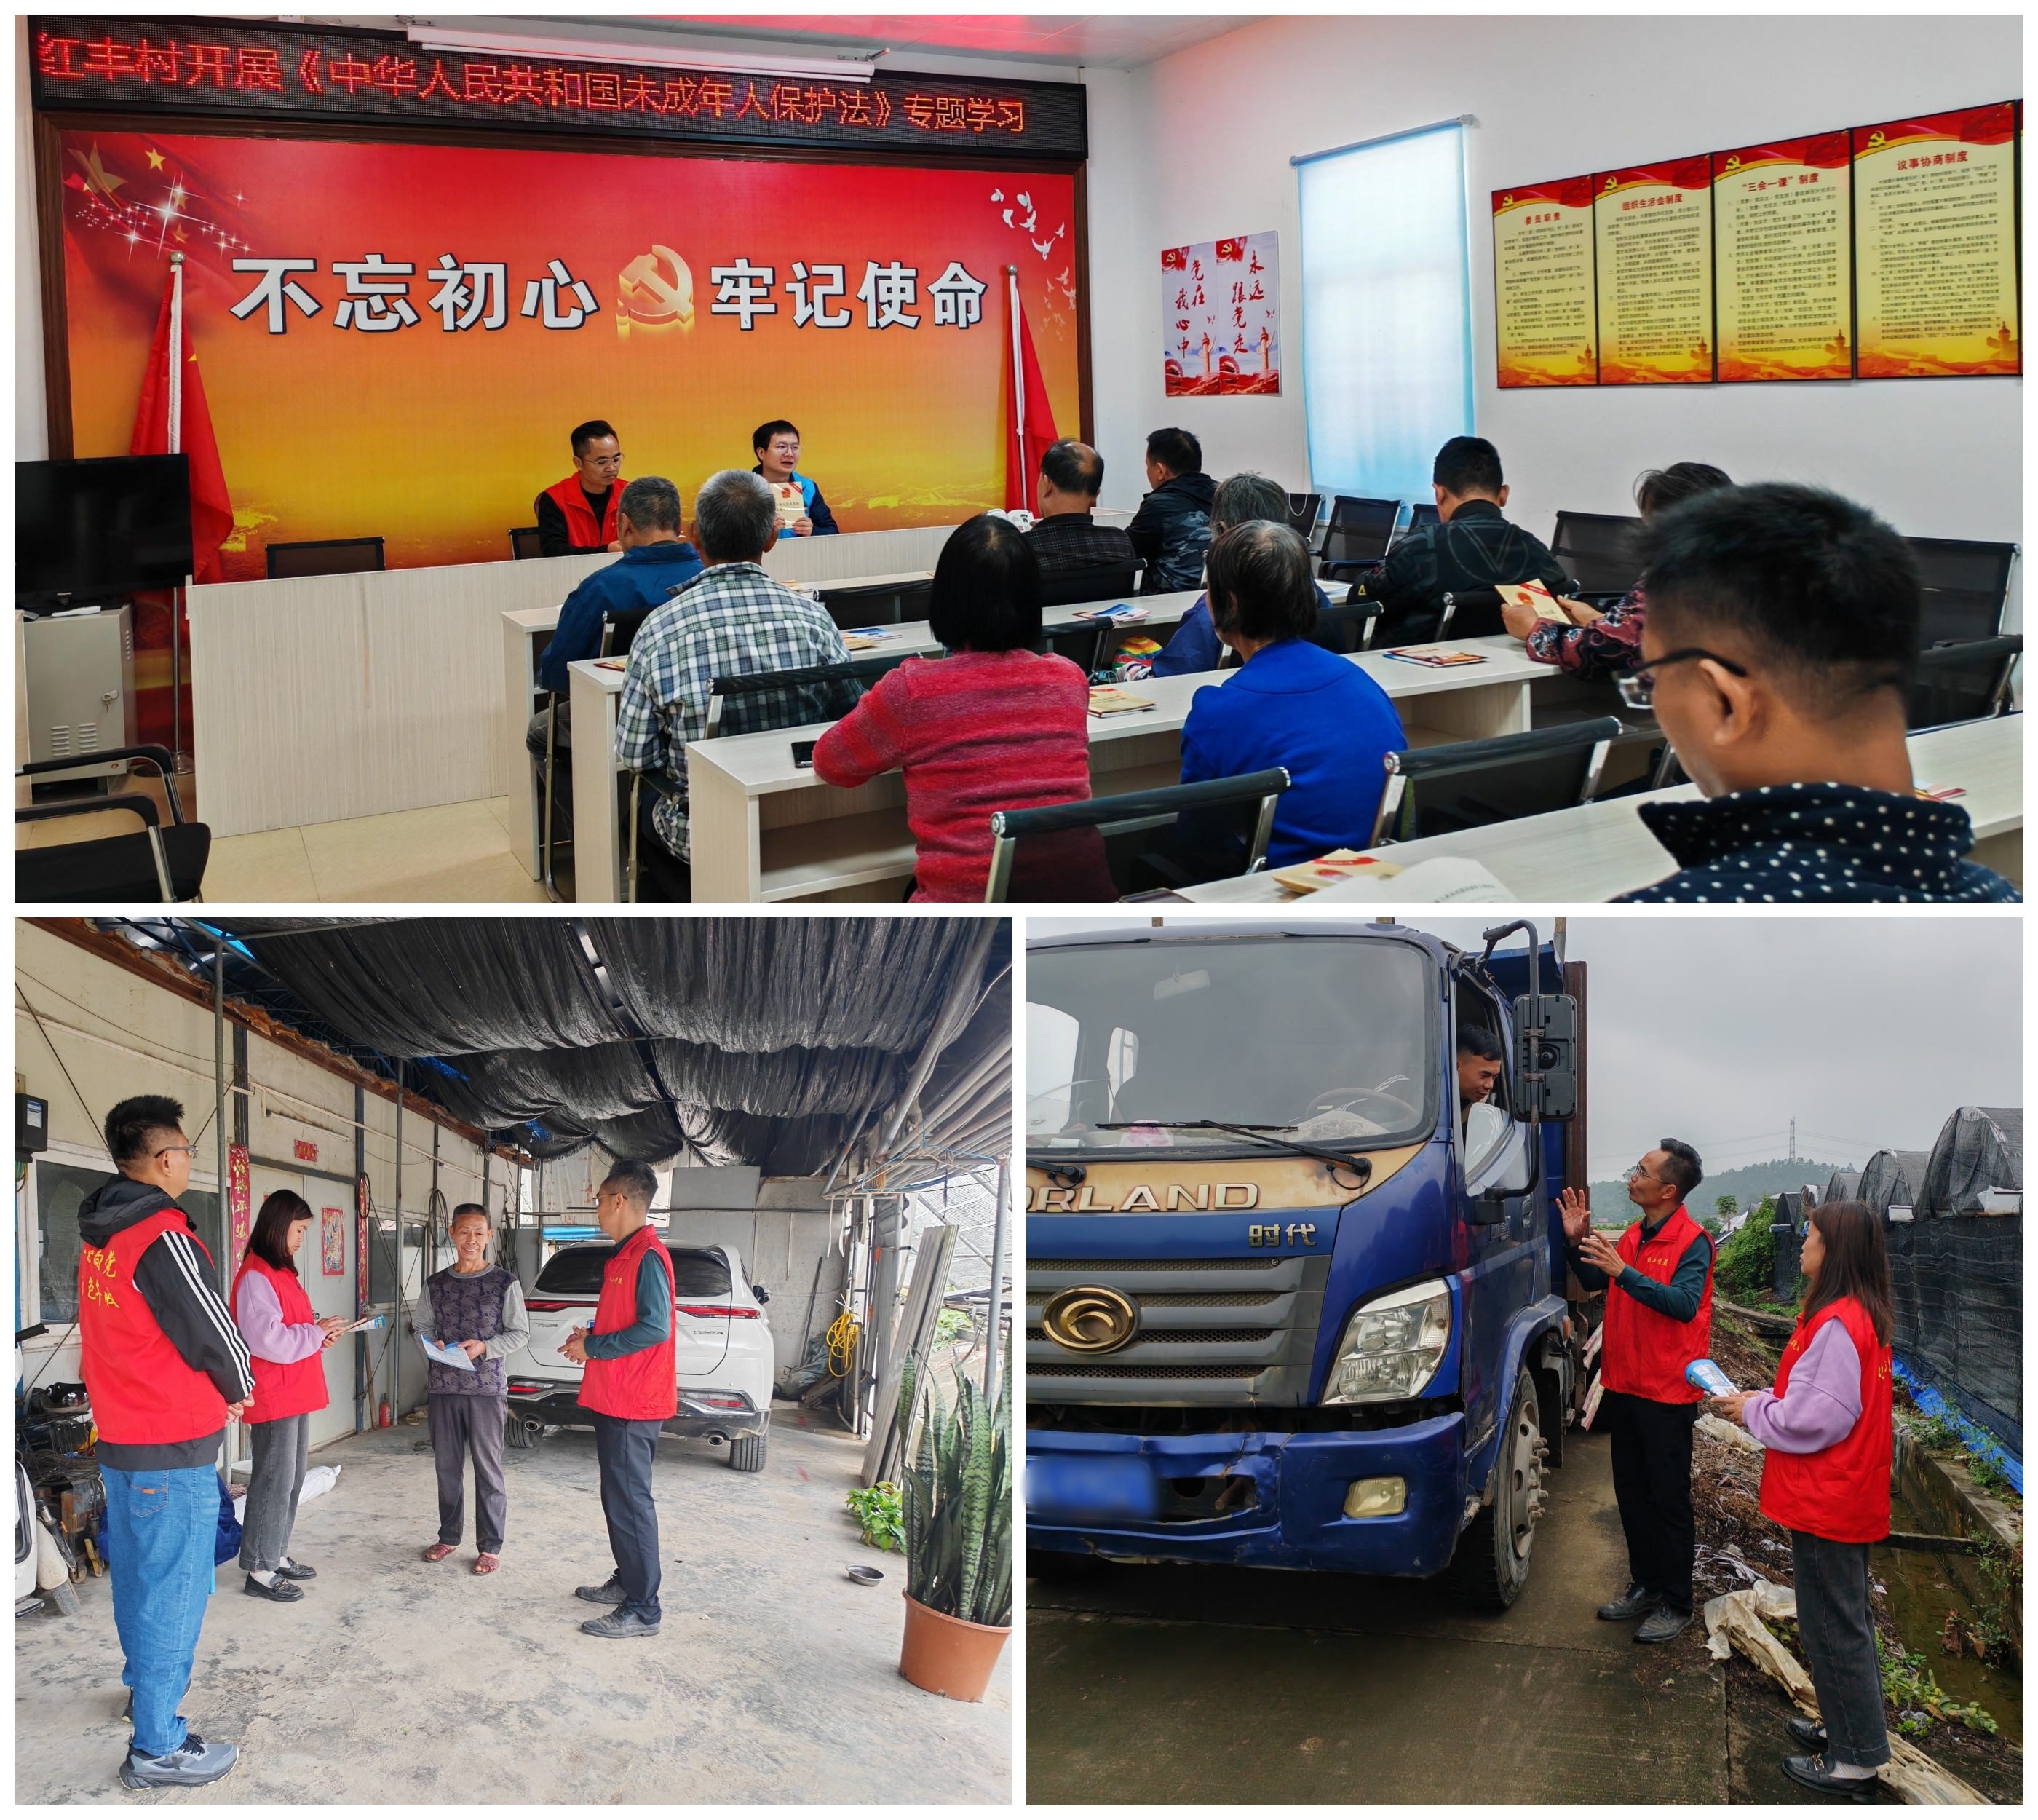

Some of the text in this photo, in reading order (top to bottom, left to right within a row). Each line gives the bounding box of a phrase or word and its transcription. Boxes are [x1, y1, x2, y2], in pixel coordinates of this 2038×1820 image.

[36, 31, 1026, 134] 红丰村开展《中华人民共和国未成年人保护法》专题学习
[1896, 150, 1969, 171] 议事协商制度
[1622, 193, 1684, 211] 组织生活会制度
[1524, 211, 1561, 226] 委员职责
[229, 252, 988, 336] 不忘初心 牢记使命
[1248, 1222, 1317, 1248] 时代
